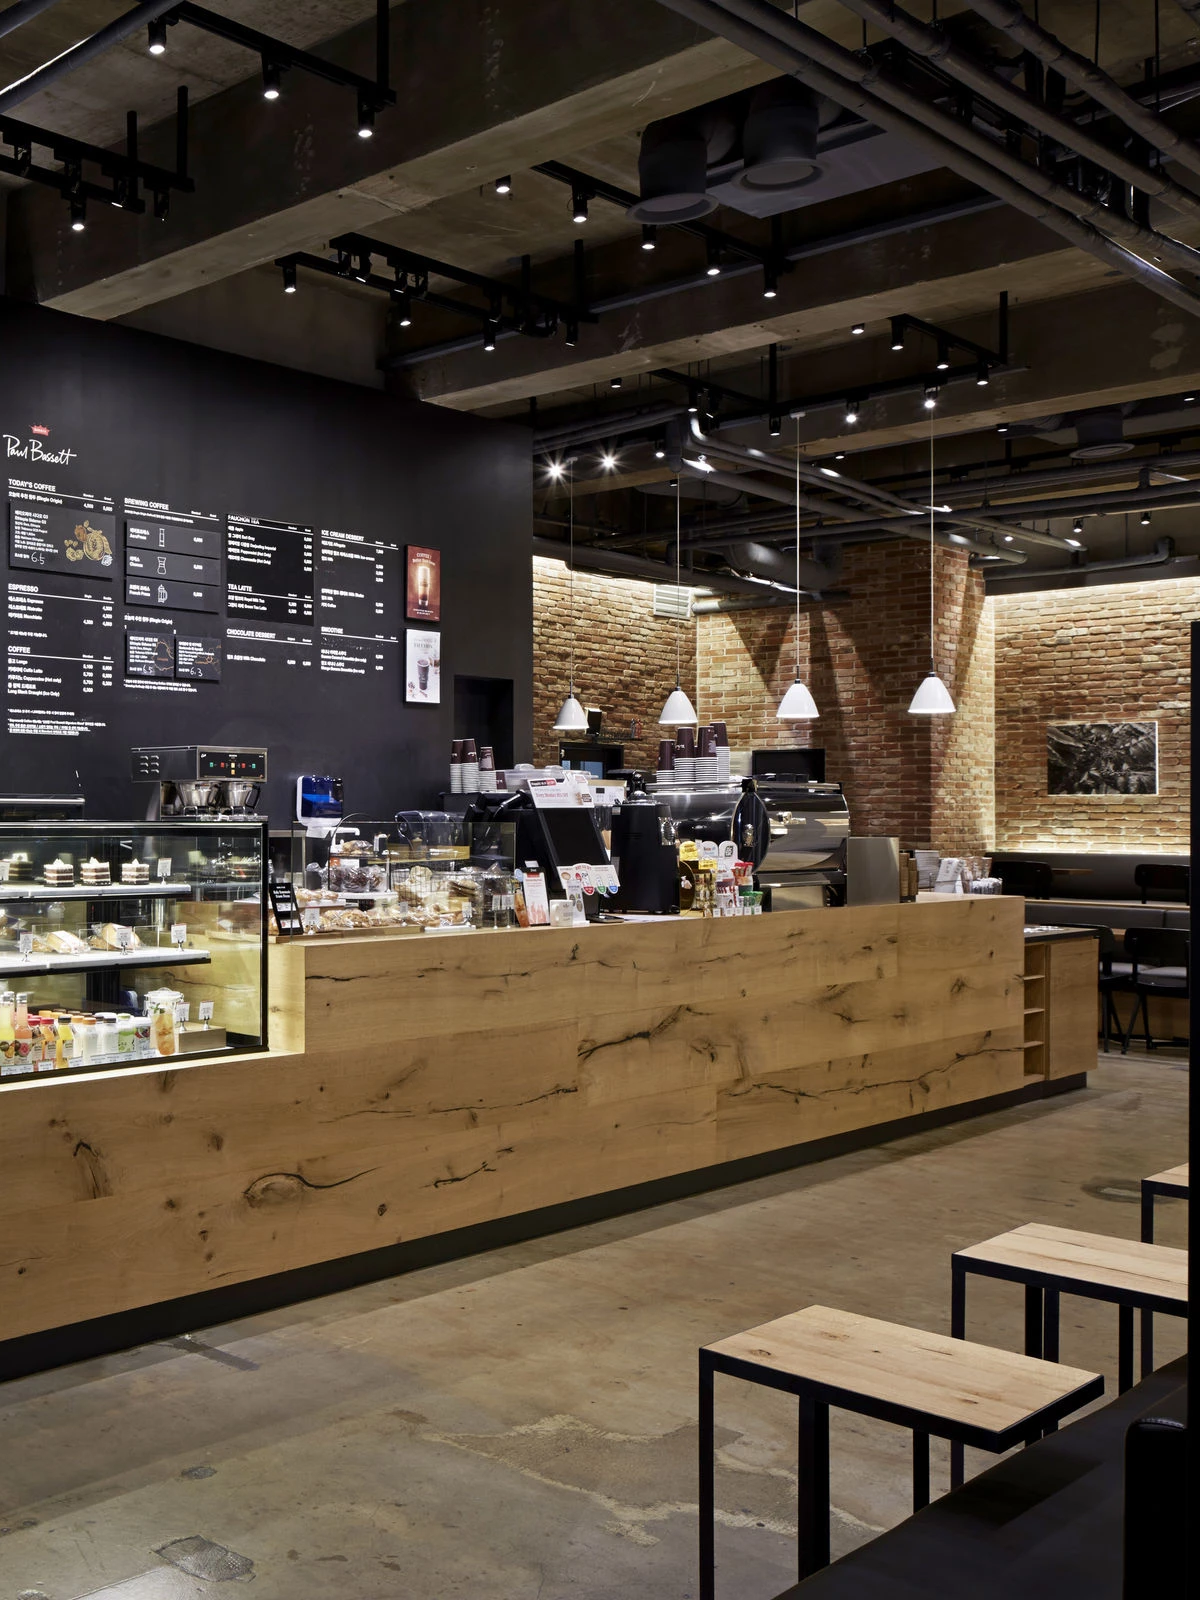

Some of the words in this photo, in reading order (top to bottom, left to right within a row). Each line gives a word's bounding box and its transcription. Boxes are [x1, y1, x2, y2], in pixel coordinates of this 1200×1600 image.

[3, 434, 28, 459] Paul
[29, 439, 77, 465] Bassett
[8, 479, 33, 488] TODAY'S
[34, 483, 56, 492] COFFEE
[124, 498, 148, 507] BREWING
[149, 501, 169, 510] COFFEE
[31, 552, 45, 565] 6.5
[8, 583, 39, 592] ESPRESSO
[227, 628, 254, 637] CHOCOLATE
